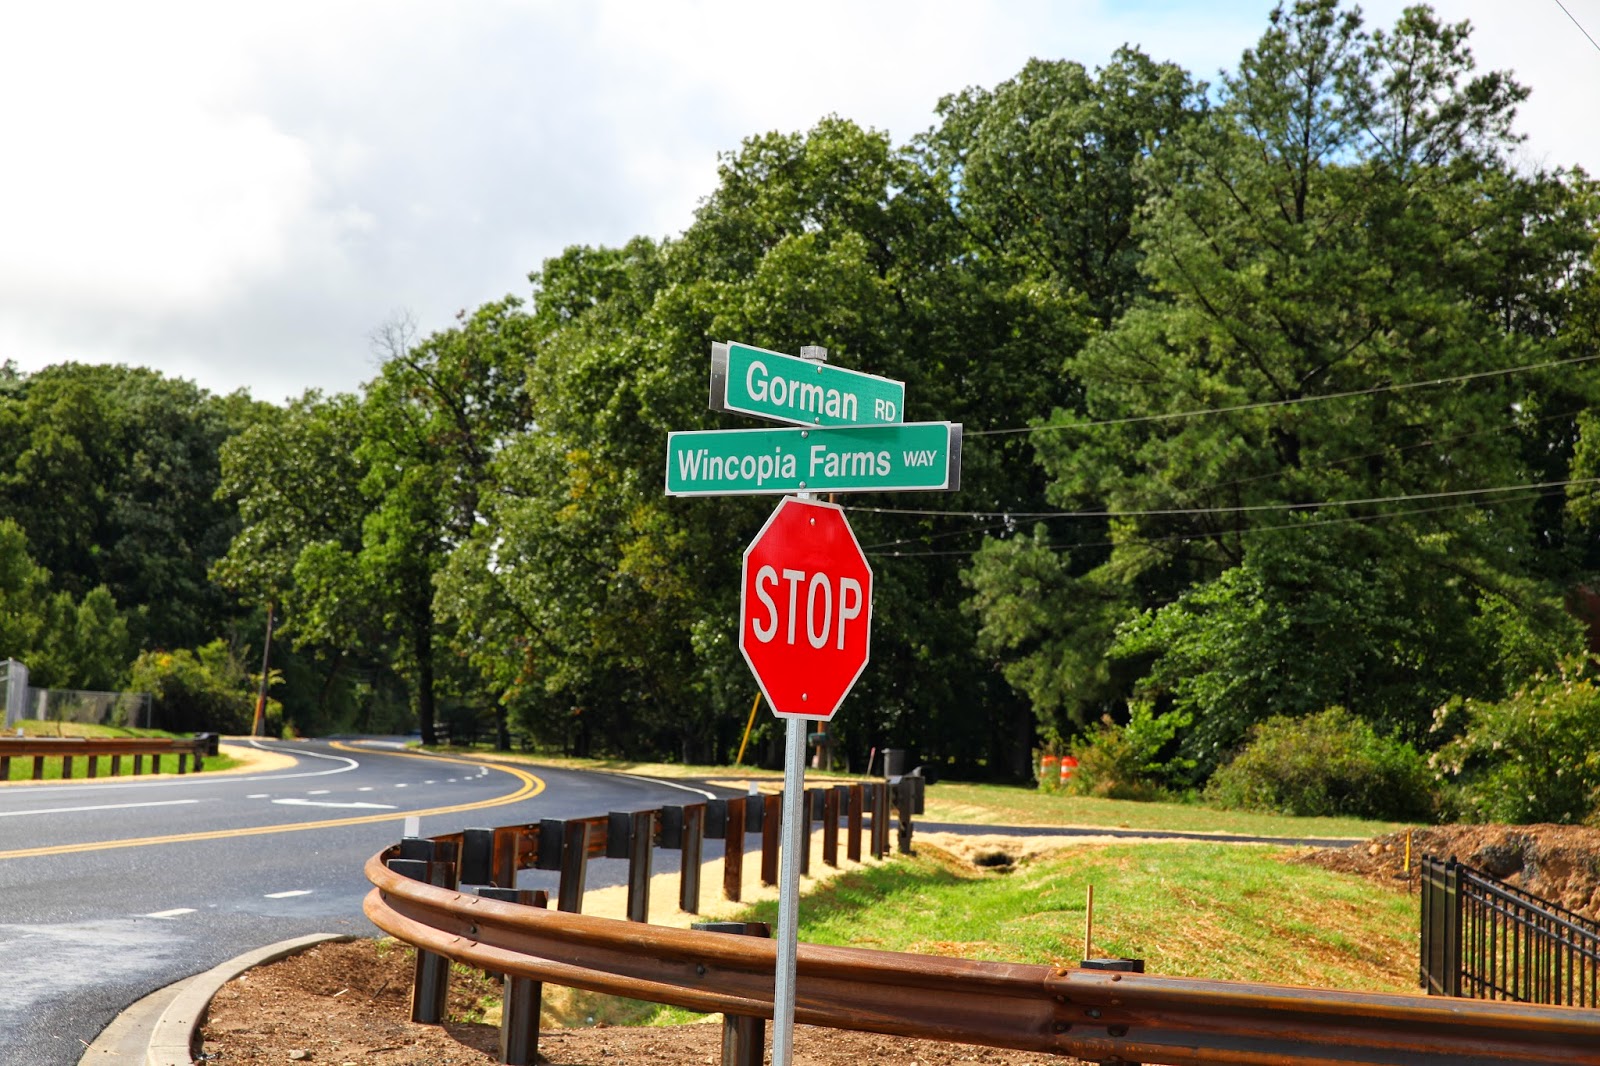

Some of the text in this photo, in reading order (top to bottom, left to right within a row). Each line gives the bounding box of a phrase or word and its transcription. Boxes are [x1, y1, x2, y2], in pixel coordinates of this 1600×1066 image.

[746, 360, 896, 422] Gorman RD
[678, 444, 937, 486] Wincopia Farms WAY
[752, 564, 863, 650] STOP
